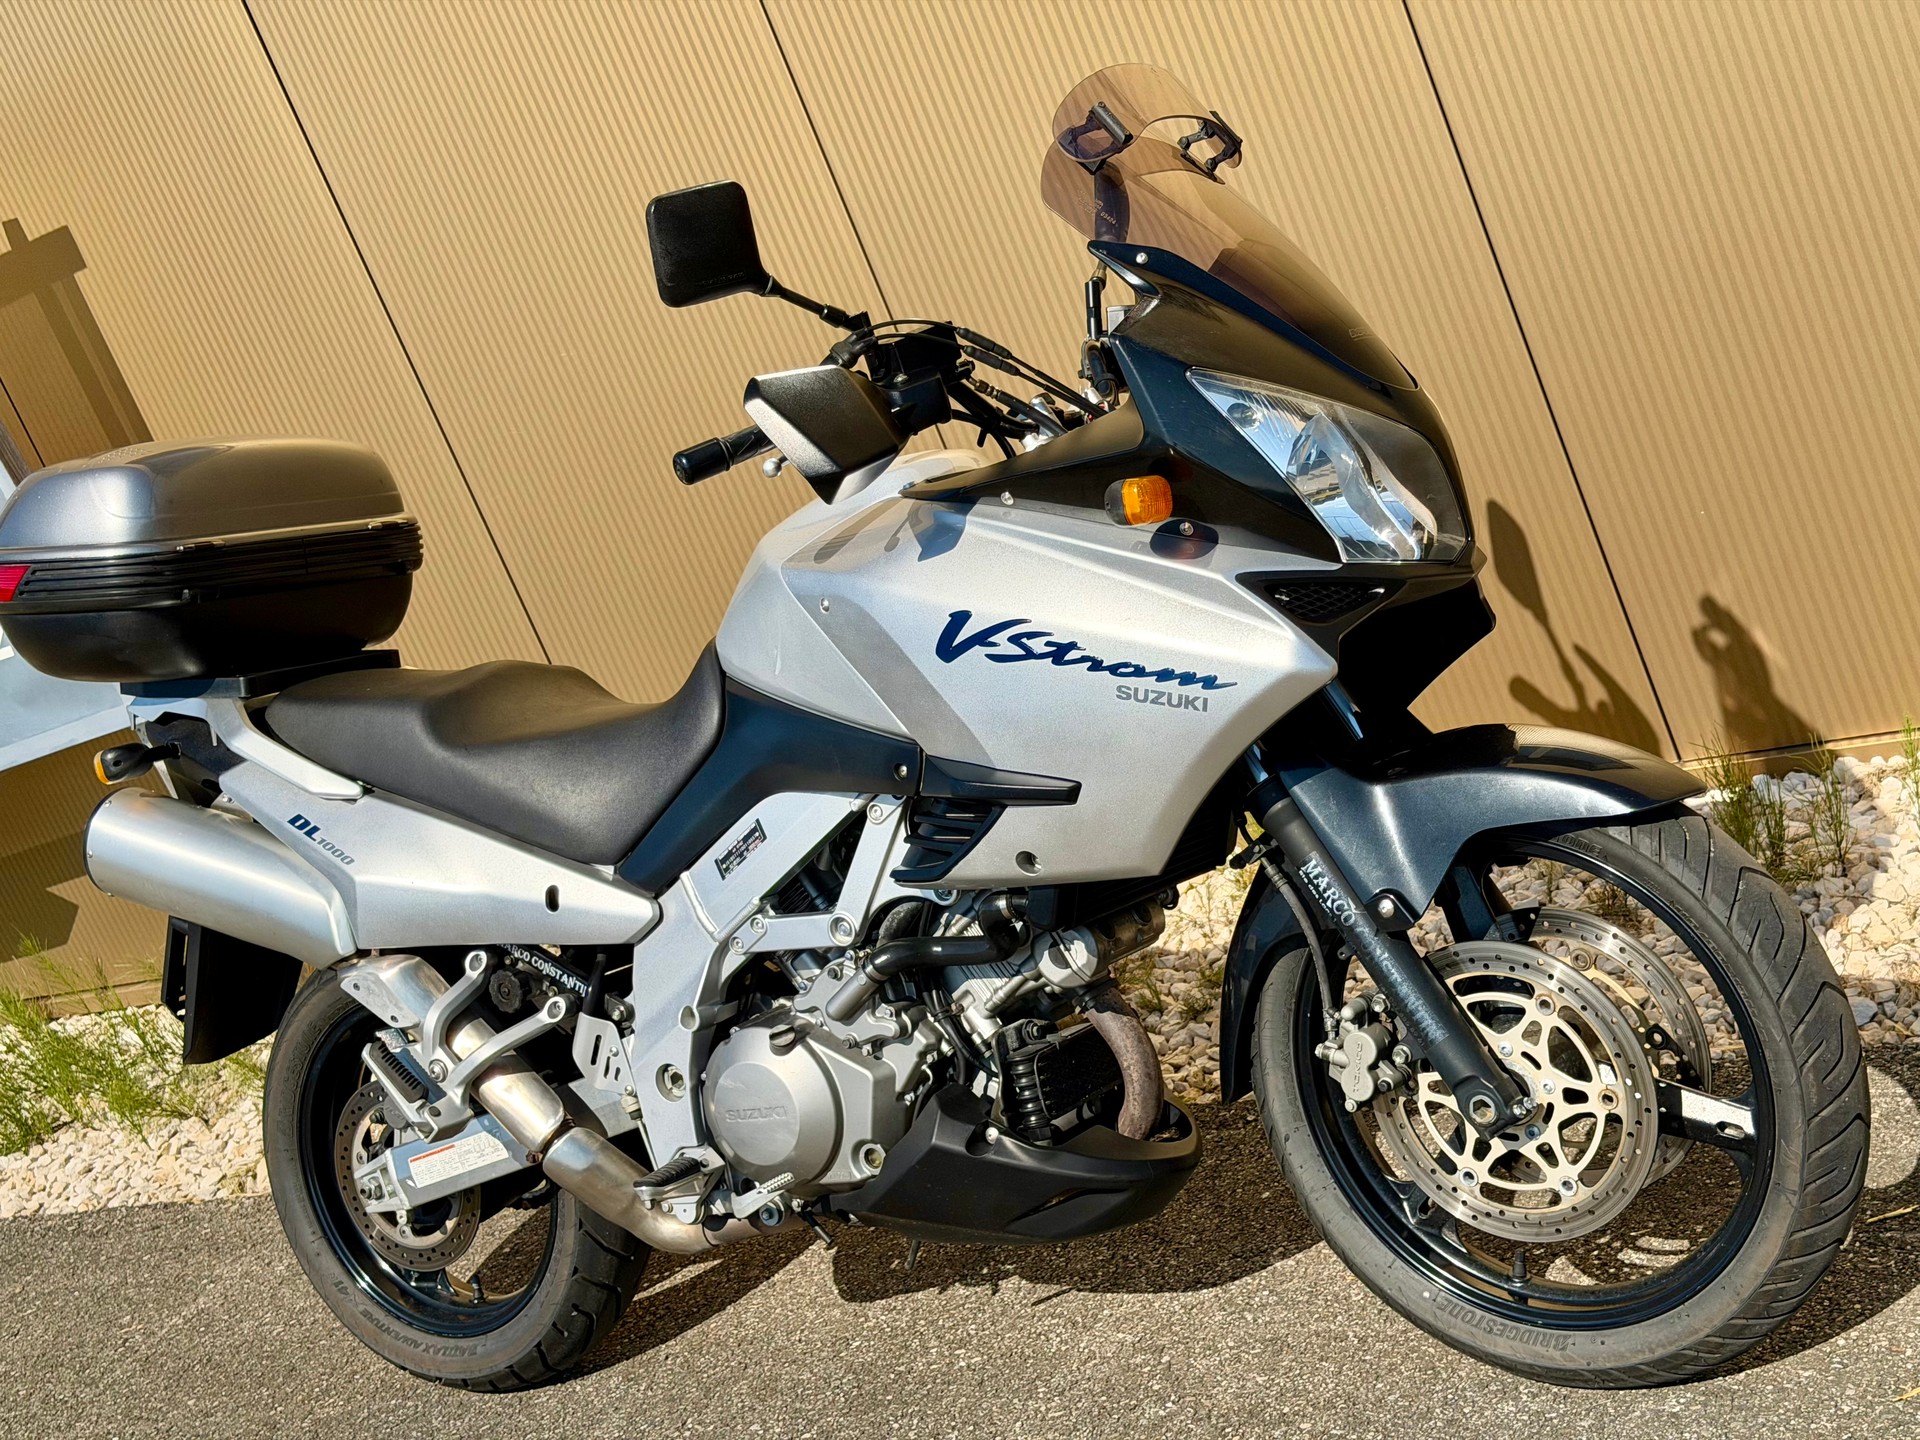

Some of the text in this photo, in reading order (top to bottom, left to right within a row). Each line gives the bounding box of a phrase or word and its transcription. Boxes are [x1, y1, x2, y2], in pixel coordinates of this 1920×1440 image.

[1116, 685, 1208, 713] SUZUKI
[1300, 859, 1356, 926] MARCO
[725, 1105, 788, 1123] SUZUKI
[358, 1308, 424, 1351] ADVENTURE
[1436, 1295, 1572, 1352] BRIDGESTONE
